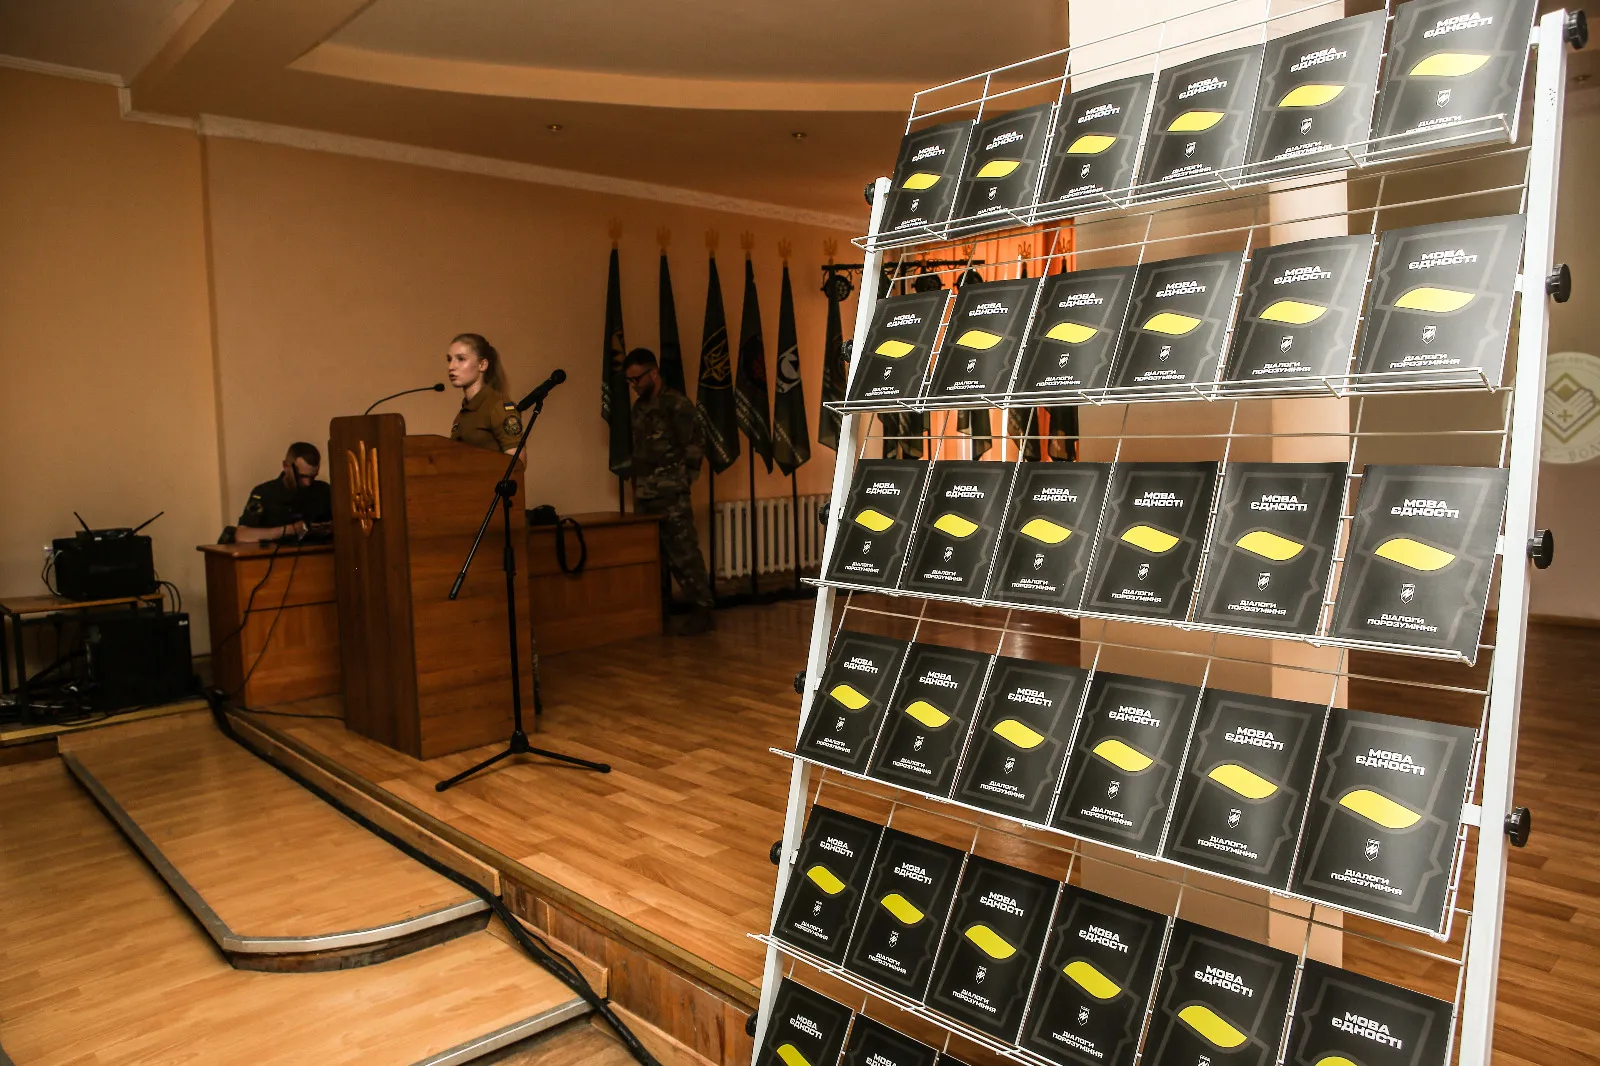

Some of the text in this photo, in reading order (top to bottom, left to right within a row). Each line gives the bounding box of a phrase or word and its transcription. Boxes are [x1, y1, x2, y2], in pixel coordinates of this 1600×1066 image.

[1436, 12, 1481, 28] МОВА
[1424, 17, 1493, 38] ЄДНОСТІ
[1291, 51, 1347, 72] ЄДНОСТІ
[1301, 48, 1336, 62] МОВА
[1179, 81, 1227, 99] ЄДНОСТІ
[1188, 77, 1219, 90] МОВА
[1078, 107, 1120, 123] ЄДНОСТІ
[1086, 104, 1112, 115] МОВА
[986, 134, 1023, 150] ЄДНОСТІ
[993, 131, 1017, 143] МОВА
[912, 149, 945, 161] ЄДНОСТІ
[918, 146, 939, 155] МОВА
[1422, 249, 1465, 260] МОВА
[1409, 255, 1477, 269] ЄДНОСТІ
[1285, 266, 1321, 276] МОВА
[1274, 272, 1331, 284] ЄДНОСТІ
[1156, 286, 1206, 297] ЄДНОСТІ
[1166, 281, 1197, 290] МОВА
[1059, 298, 1103, 307] ЄДНОСТІ
[1068, 293, 1095, 301] МОВА
[969, 308, 1008, 316] ЄДНОСТІ
[887, 318, 921, 327] ЄДНОСТІ
[1390, 359, 1460, 368] ПОРОЗУМІННЯ
[1403, 354, 1447, 362] ДІАЛОГИ
[1252, 366, 1311, 375] ПОРОЗУМІННЯ
[1263, 361, 1300, 369] ДІАЛОГИ
[1134, 499, 1183, 507] ЄДНОСТІ
[1262, 495, 1298, 503] МОВА
[1404, 499, 1447, 509] МОВА
[1251, 502, 1307, 511] ЄДНОСТІ
[1391, 507, 1459, 518] ЄДНОСТІ
[1012, 582, 1056, 591] ПОРОЗУМІННЯ
[1112, 593, 1161, 602] ПОРОЗУМІННЯ
[1240, 600, 1276, 608] ДІАЛОГИ
[1228, 604, 1286, 615] ПОРОЗУМІННЯ
[1368, 619, 1437, 632] ПОРОЗУМІННЯ
[1381, 614, 1424, 624] ДІАЛОГИ
[844, 662, 878, 673] ЄДНОСТІ
[851, 657, 872, 666] МОВА
[927, 671, 951, 681] МОВА
[919, 677, 958, 689] ЄДНОСТІ
[1017, 688, 1044, 698] МОВА
[1008, 693, 1052, 707] ЄДНОСТІ
[1119, 706, 1151, 718] МОВА
[1109, 711, 1160, 727] ЄДНОСТІ
[1237, 727, 1274, 740] МОВА
[1225, 733, 1284, 750] ЄДНОСТІ
[900, 758, 925, 768] ДІАЛОГИ
[1369, 749, 1413, 764] МОВА
[893, 761, 931, 774] ПОРОЗУМІННЯ
[1356, 756, 1425, 775] ЄДНОСТІ
[980, 784, 1025, 799] ПОРОЗУМІННЯ
[989, 781, 1017, 791] ДІАЛОГИ
[1081, 809, 1132, 826] ПОРОЗУМІННЯ
[1091, 806, 1124, 818] ДІАЛОГИ
[820, 841, 853, 857] ЄДНОСТІ
[827, 837, 848, 849] МОВА
[1198, 839, 1257, 859] ПОРОЗУМІННЯ
[1210, 836, 1247, 850] ДІАЛОГИ
[894, 867, 932, 884] ЄДНОСТІ
[902, 863, 925, 875] МОВА
[1331, 873, 1402, 895] ПОРОЗУМІННЯ
[1345, 870, 1389, 885] ДІАЛОГИ
[980, 896, 1024, 916] ЄДНОСТІ
[989, 892, 1016, 907] МОВА
[1089, 925, 1119, 942] МОВА
[1079, 930, 1128, 953] ЄДНОСТІ
[868, 955, 906, 974] ПОРОЗУМІННЯ
[876, 953, 900, 966] ДІАЛОГИ
[1206, 965, 1243, 985] МОВА
[1195, 971, 1253, 997] ЄДНОСТІ
[952, 991, 996, 1014] ПОРОЗУМІННЯ
[961, 989, 989, 1004] ДІАЛОГИ
[790, 1018, 822, 1039] ЄДНОСТІ
[797, 1014, 817, 1030] МОВА
[1345, 1012, 1390, 1035] МОВА
[1062, 1031, 1094, 1048] ДІАЛОГИ
[1332, 1018, 1402, 1049] ЄДНОСТІ
[1052, 1033, 1103, 1059] ПОРОЗУМІННЯ
